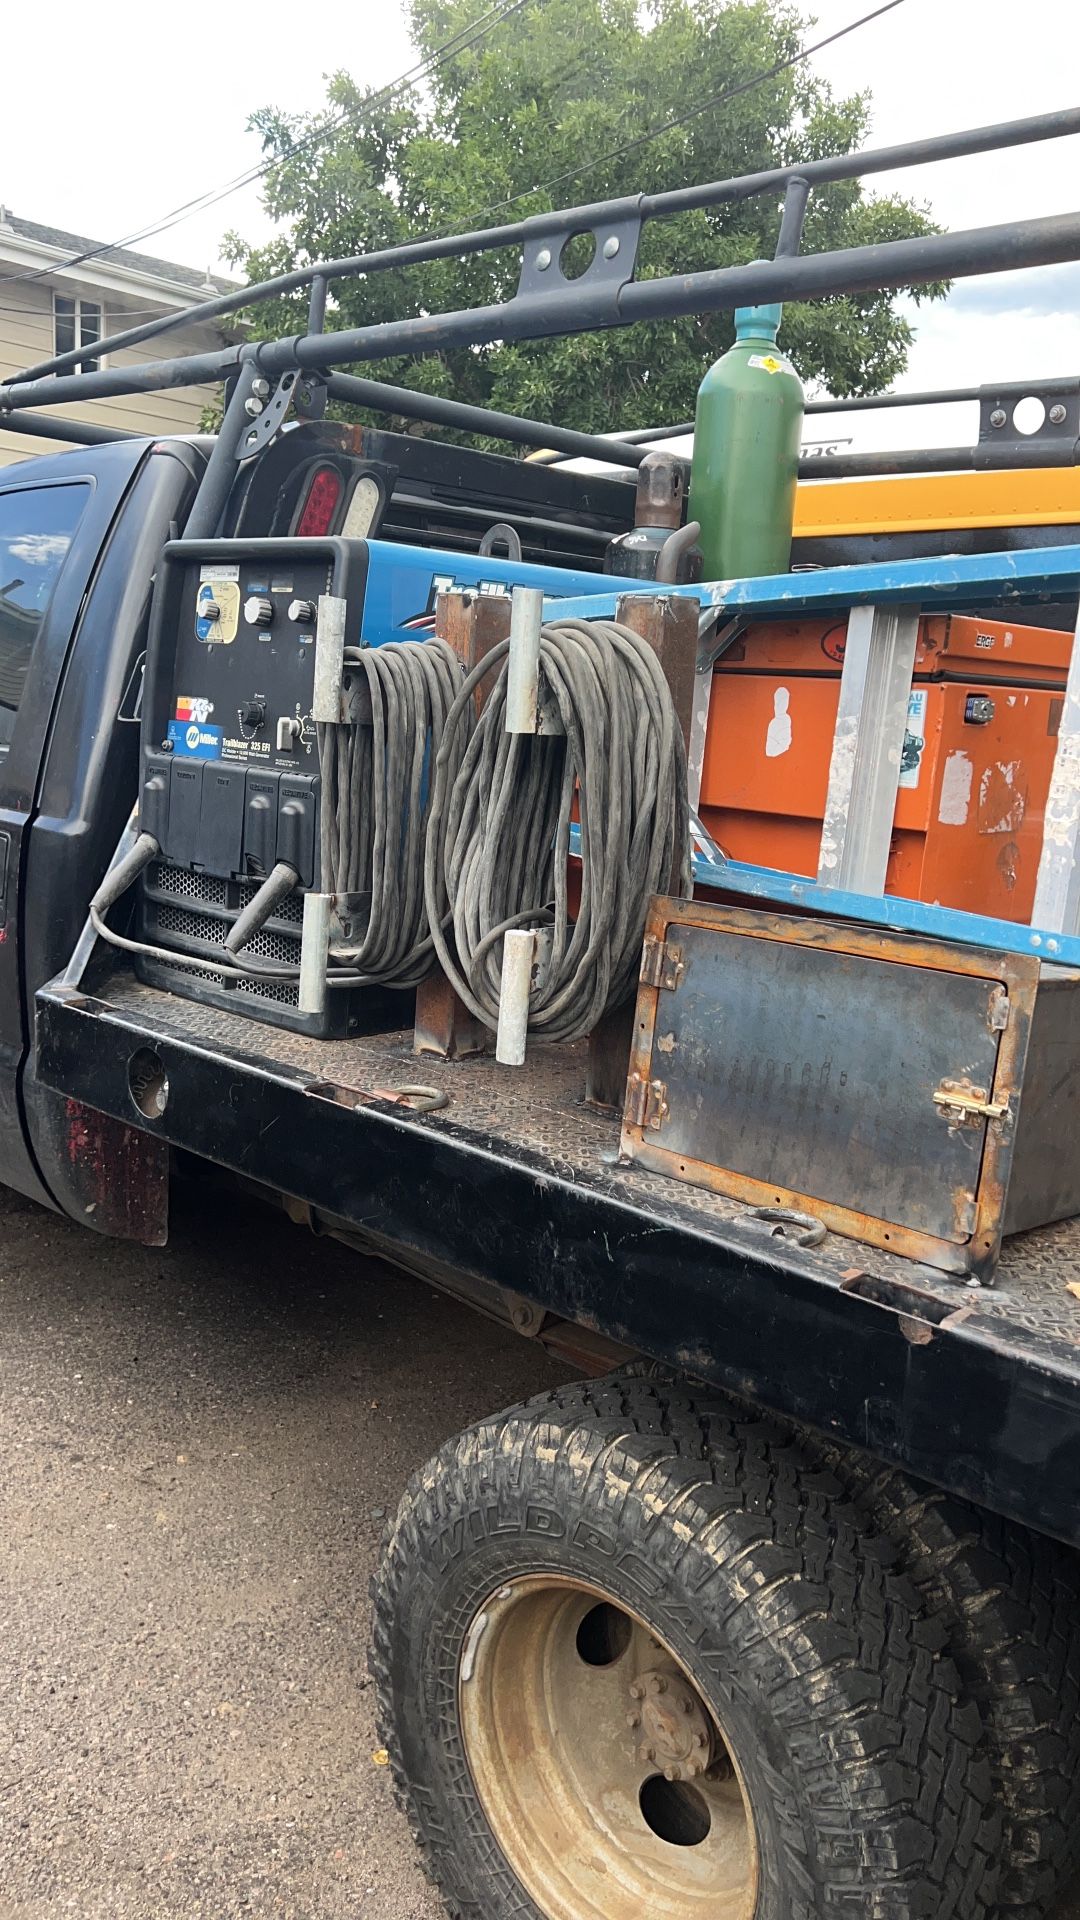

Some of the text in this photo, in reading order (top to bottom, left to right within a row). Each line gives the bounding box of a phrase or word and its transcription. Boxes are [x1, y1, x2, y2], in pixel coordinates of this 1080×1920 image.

[200, 733, 218, 745] Miller
[222, 738, 270, 752] Trailblazer 325 EFI
[430, 1503, 752, 1703] WILDPEAK
